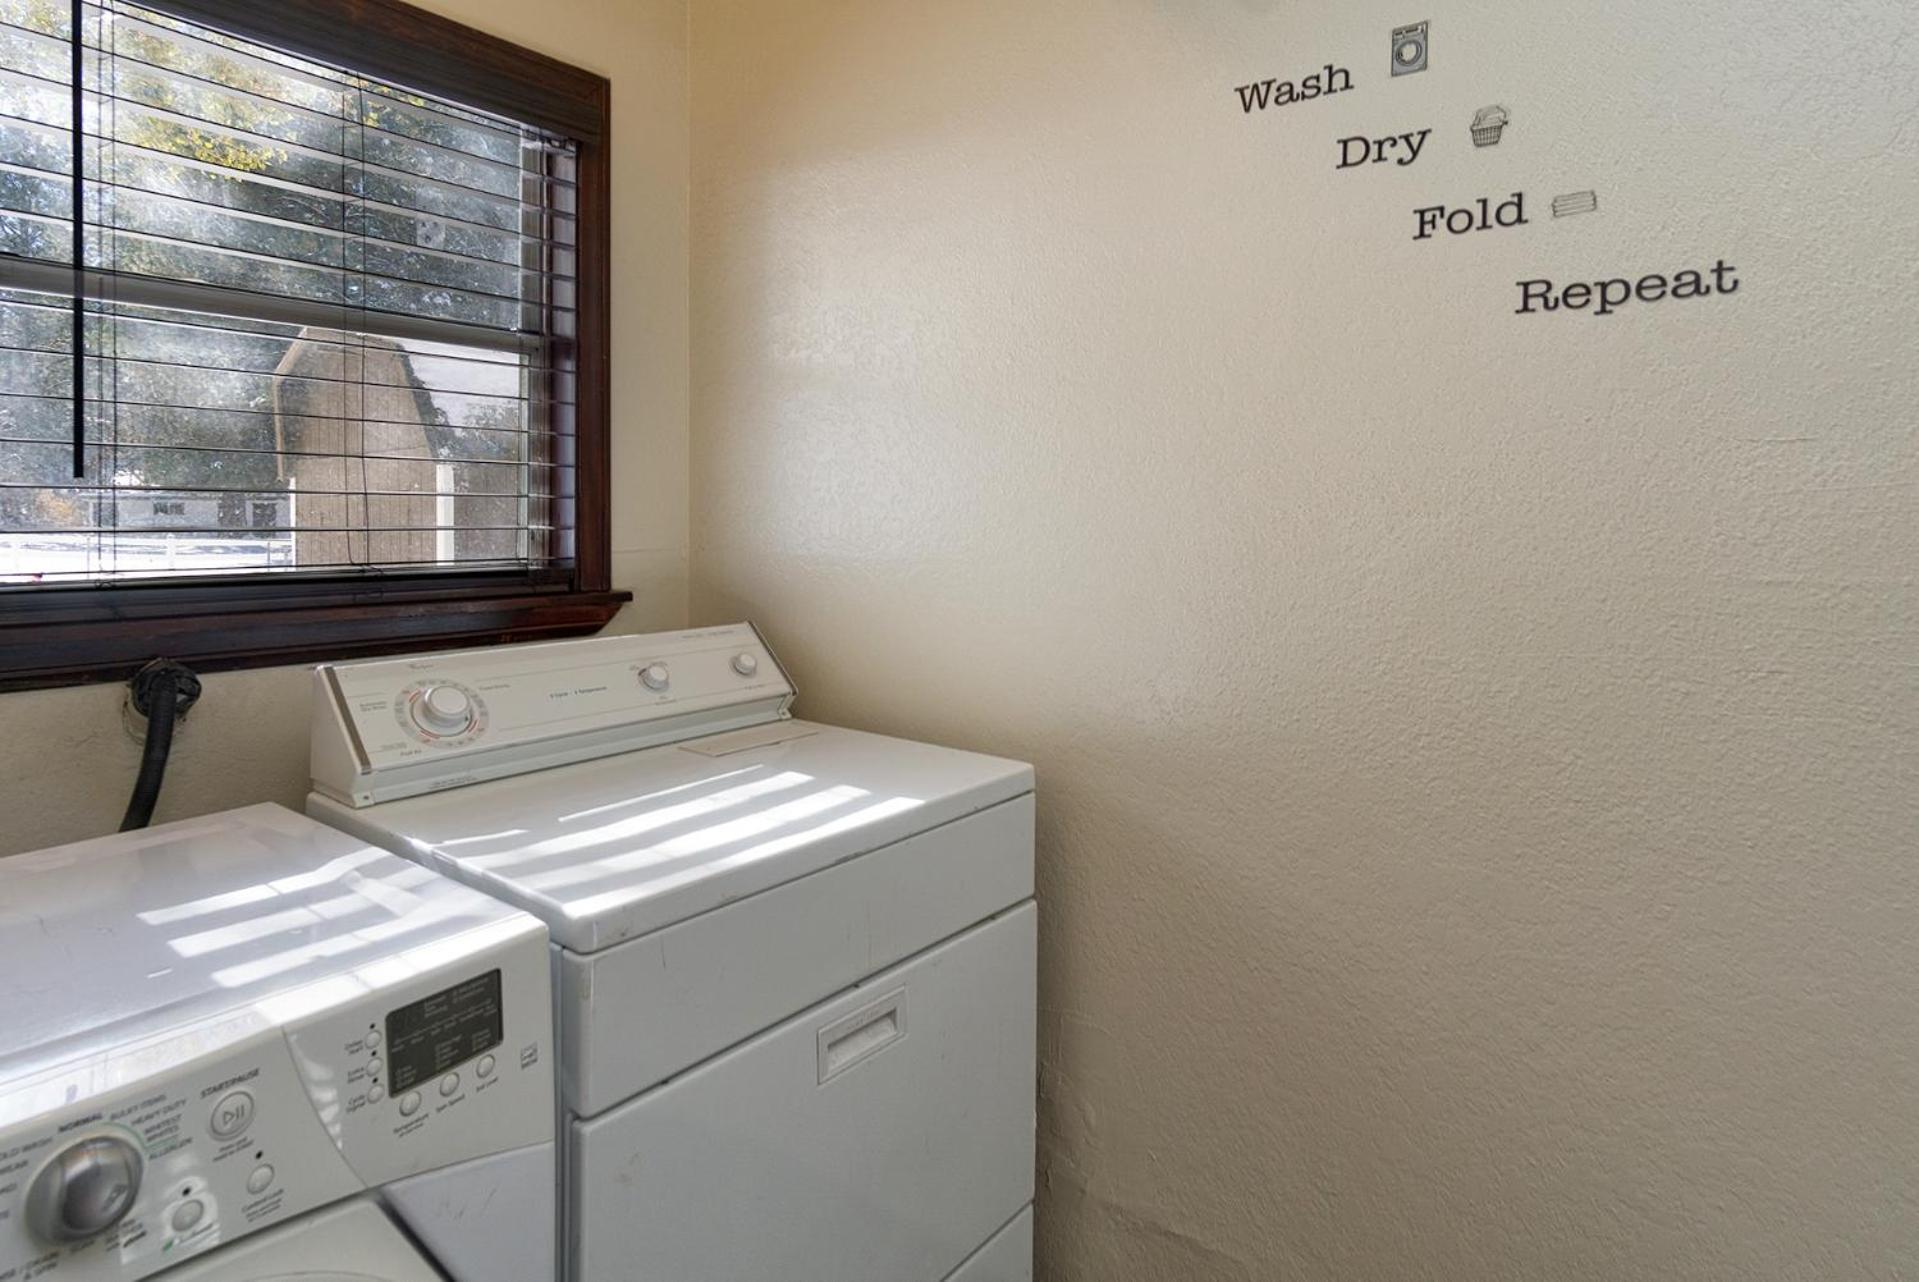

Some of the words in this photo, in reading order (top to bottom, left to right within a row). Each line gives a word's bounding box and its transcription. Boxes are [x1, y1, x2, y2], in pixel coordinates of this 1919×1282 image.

[1234, 63, 1355, 114] Wash
[1335, 128, 1432, 169] Dry
[1412, 191, 1529, 241] Fold
[1514, 259, 1740, 316] Repeat
